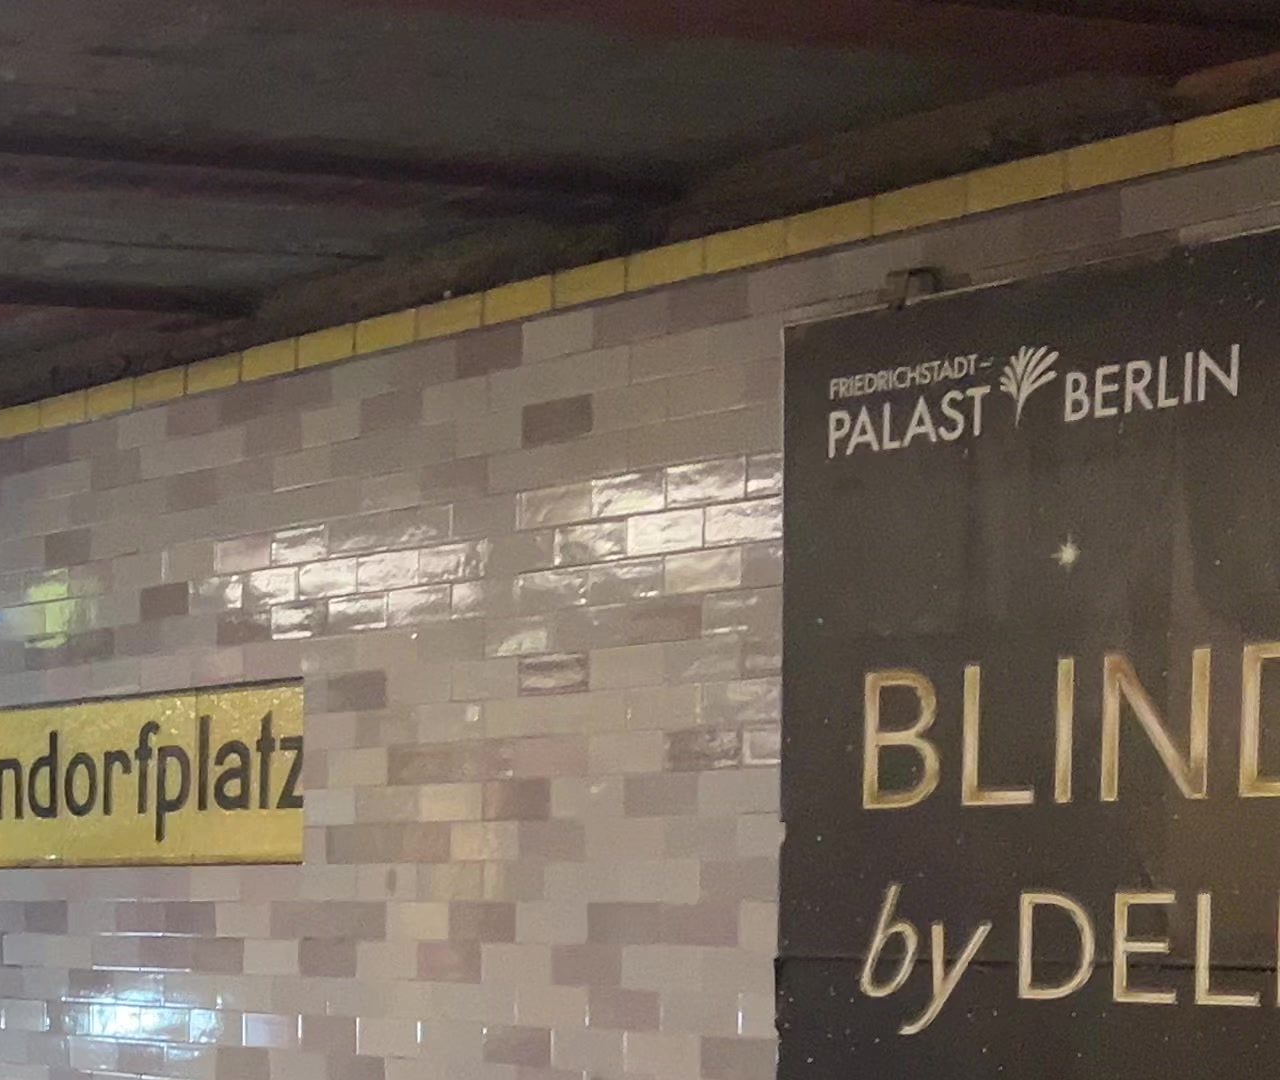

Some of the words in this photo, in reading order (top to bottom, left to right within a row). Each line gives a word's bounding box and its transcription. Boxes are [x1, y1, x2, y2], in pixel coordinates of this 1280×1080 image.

[828, 385, 991, 459] PALAST
[1064, 343, 1241, 422] BERLIN
[829, 353, 993, 401] FRIEDRICHSTADT-
[858, 882, 993, 1036] by
[1017, 889, 1280, 1007] DEL
